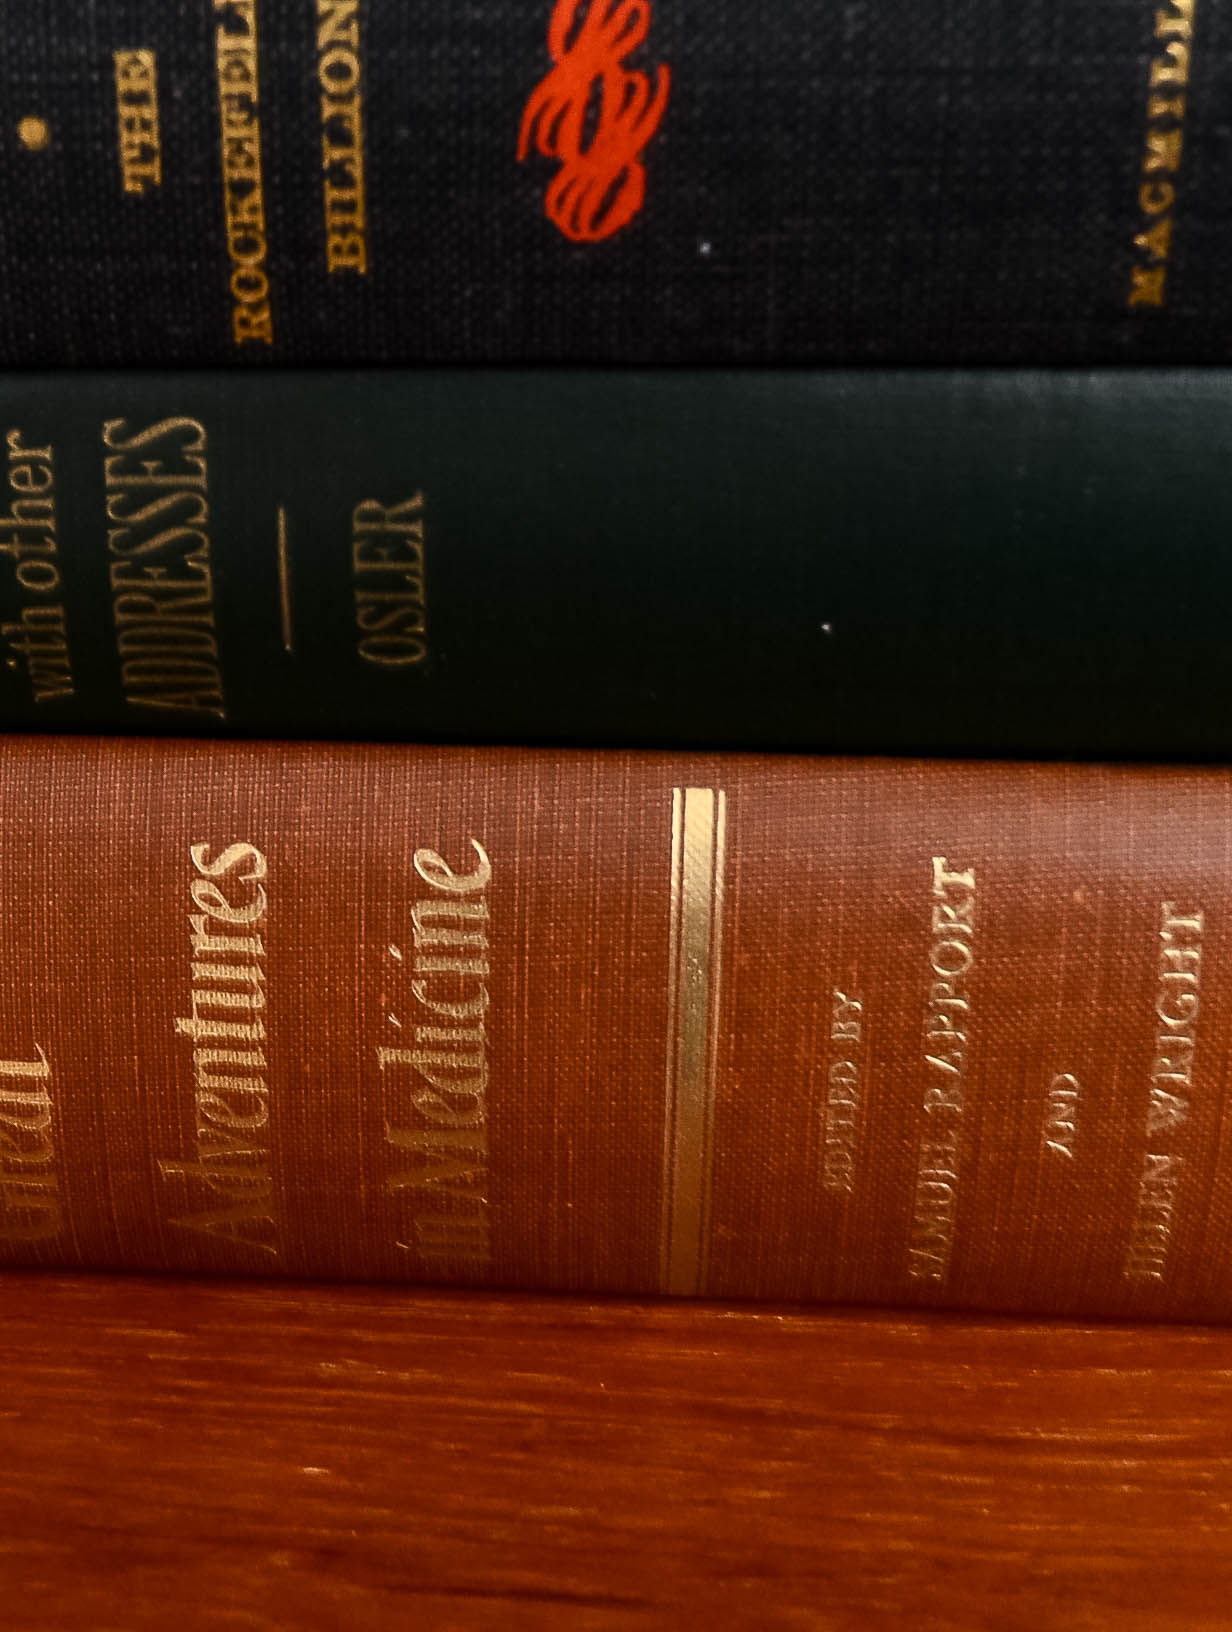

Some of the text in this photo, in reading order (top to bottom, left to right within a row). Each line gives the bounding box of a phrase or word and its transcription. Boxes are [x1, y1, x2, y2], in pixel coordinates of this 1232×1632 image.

[113, 48, 162, 193] THE
[213, 0, 273, 345] ROCKEFEL
[315, 0, 366, 275] BILLION
[0, 604, 74, 702] with
[103, 416, 227, 720] ADDRESSES
[353, 488, 428, 667] OSLER
[158, 841, 278, 1256] Adventures
[376, 838, 492, 1200] Medicine
[822, 986, 864, 1193] EDITED BY
[922, 856, 976, 1114] RAPPORT
[1146, 901, 1205, 1137] WRIGHT
[1044, 1073, 1081, 1158] AND
